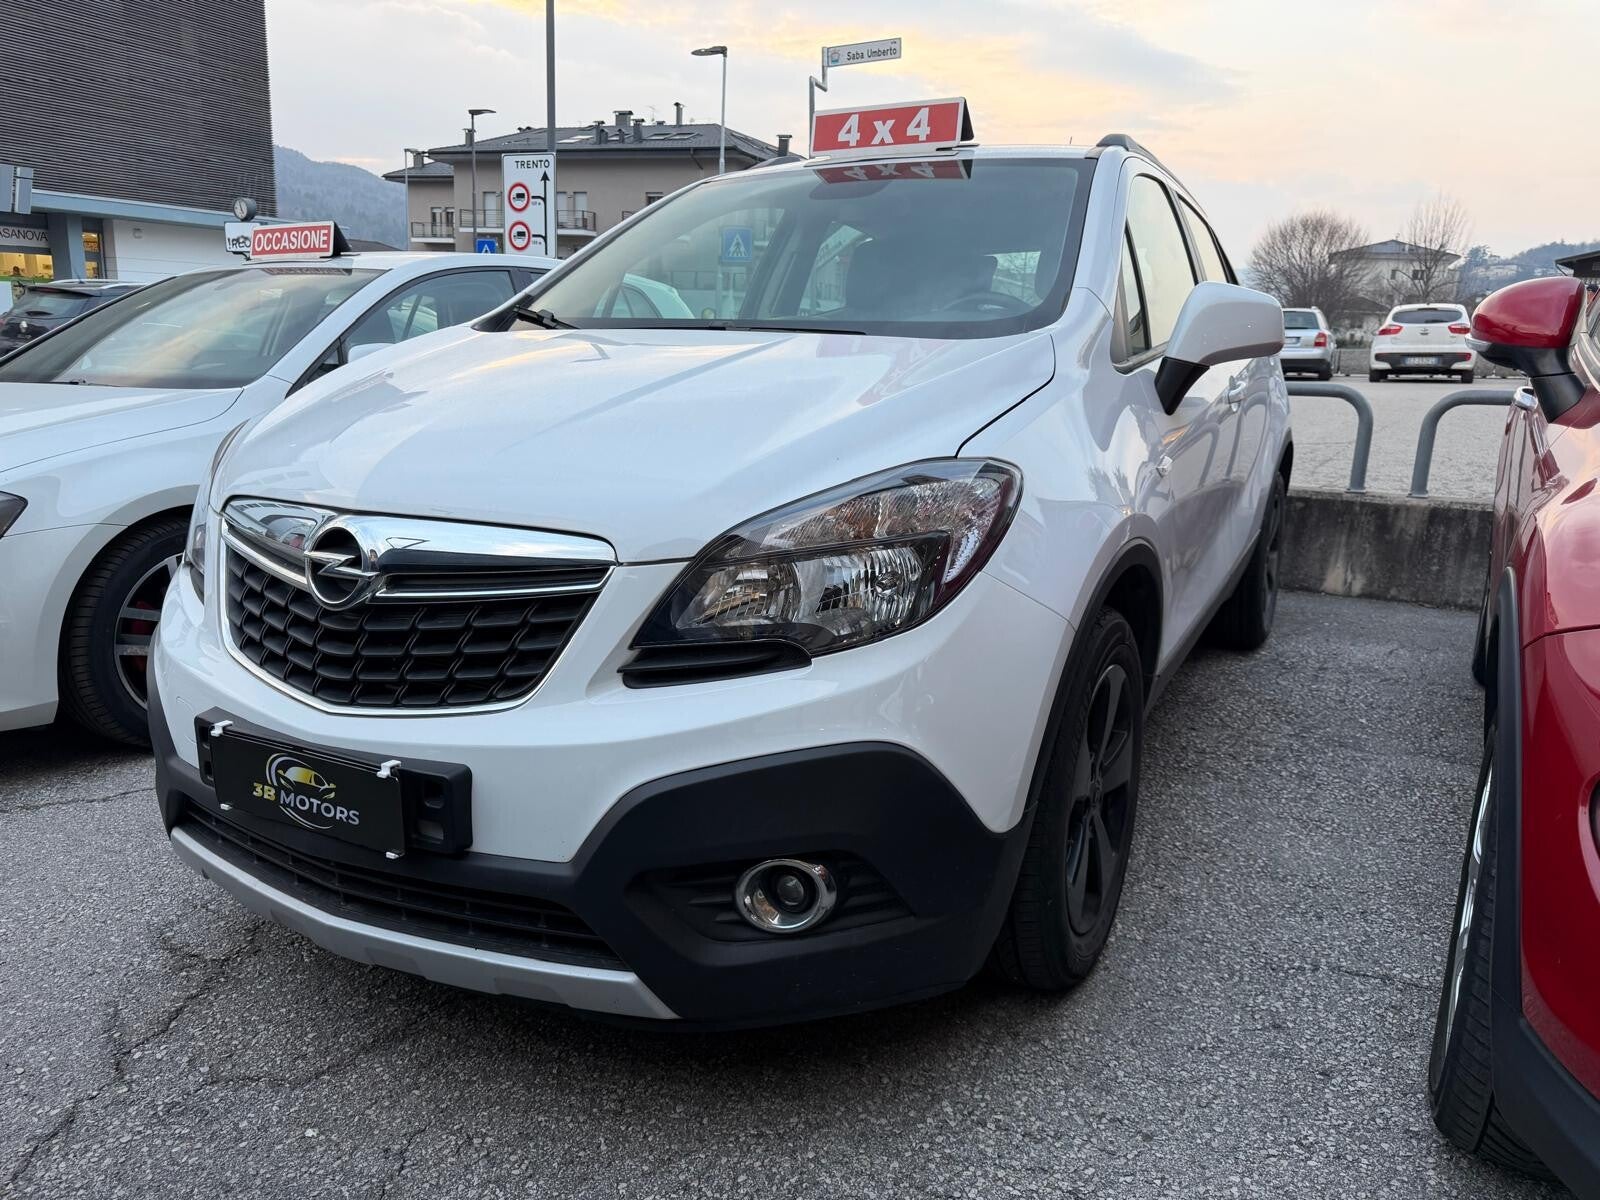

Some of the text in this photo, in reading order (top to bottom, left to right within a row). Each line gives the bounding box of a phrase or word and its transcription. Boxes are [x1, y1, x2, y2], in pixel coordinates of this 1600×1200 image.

[846, 46, 897, 61] Saba Umberto
[837, 107, 931, 147] 4 x 4
[514, 159, 550, 169] TRENTO
[0, 227, 48, 242] SANOVA
[254, 229, 329, 252] OCCASIONE
[252, 782, 360, 826] 3B MOTORS
